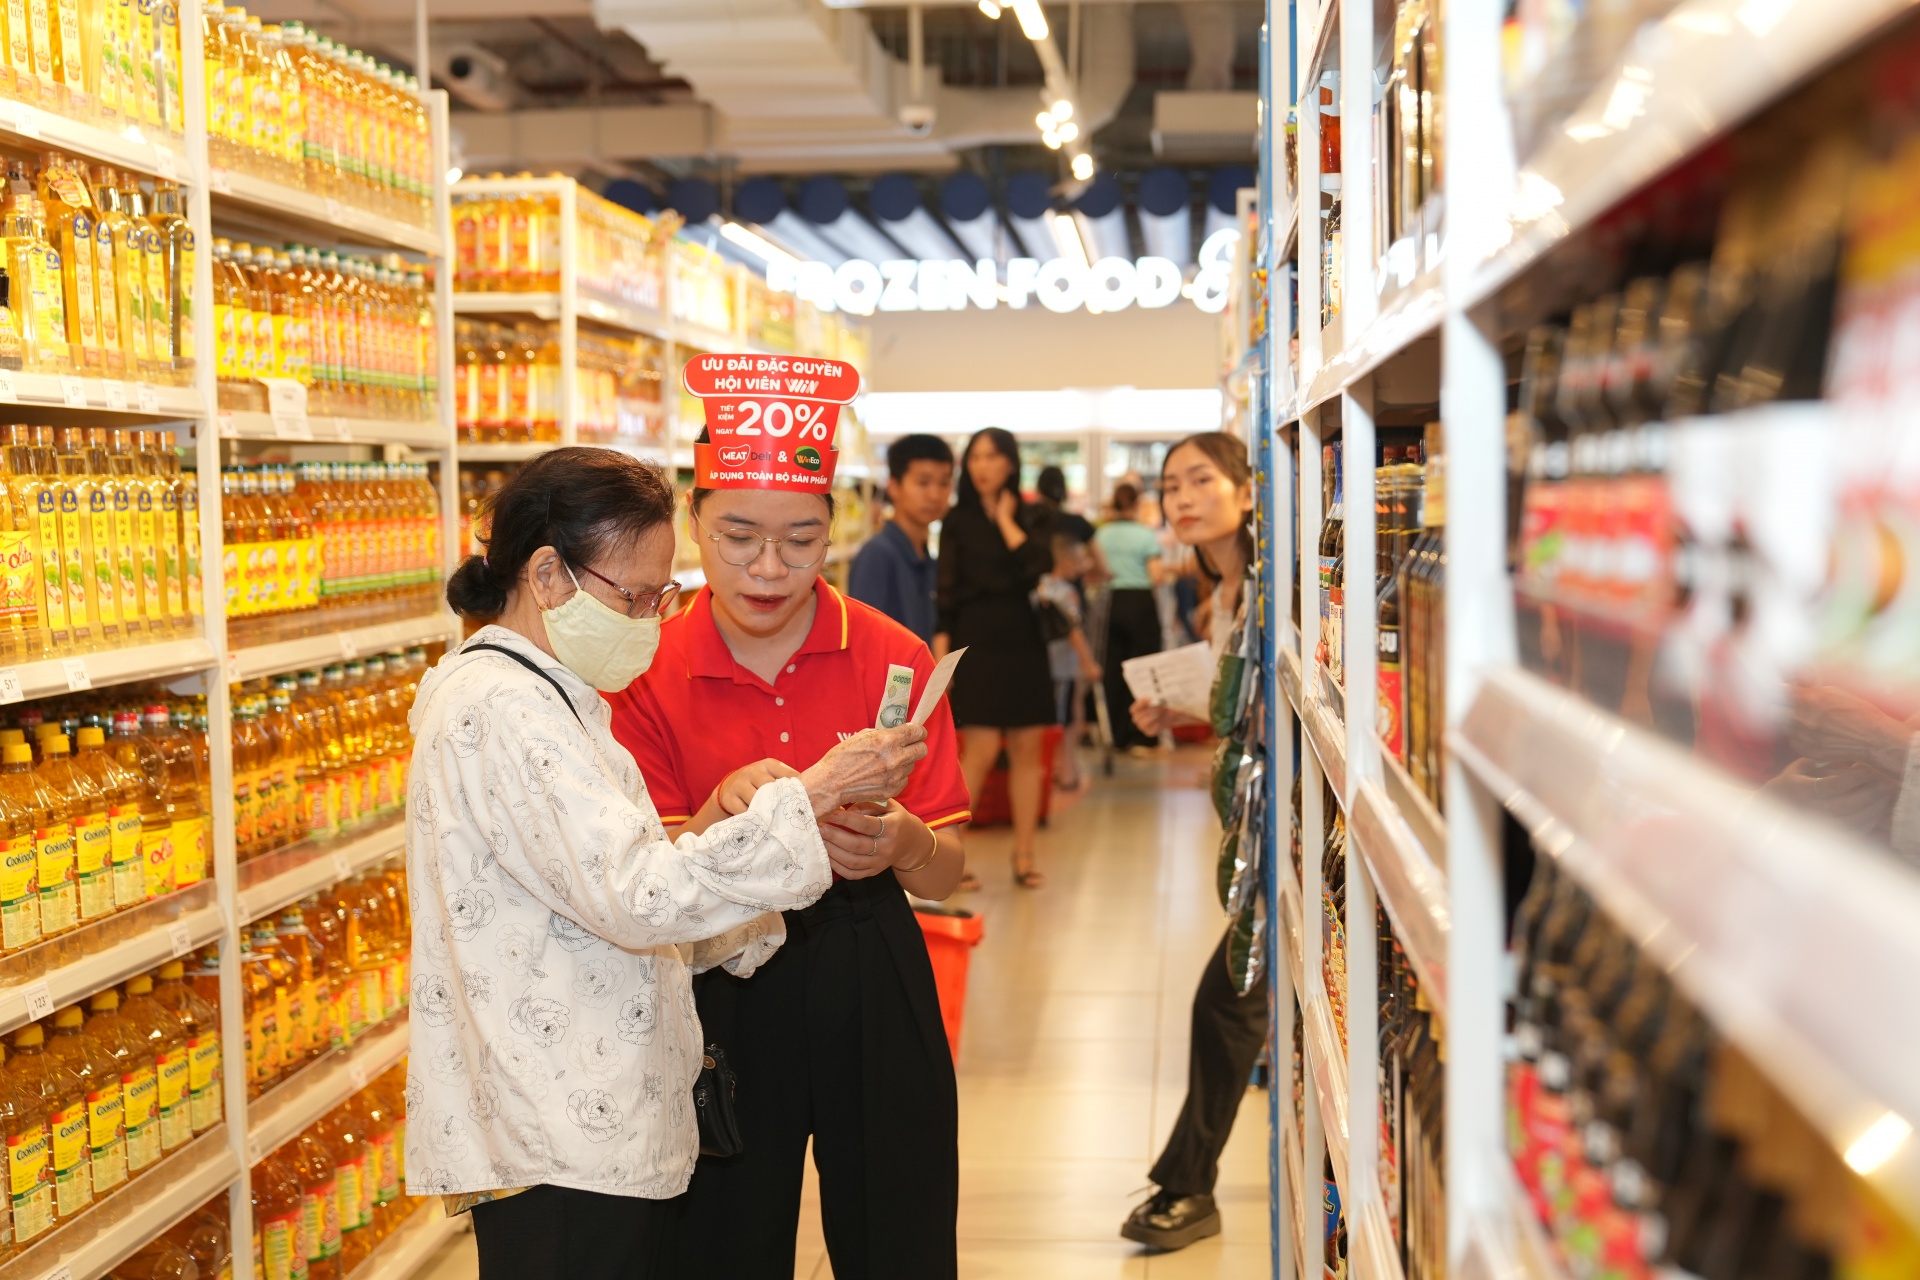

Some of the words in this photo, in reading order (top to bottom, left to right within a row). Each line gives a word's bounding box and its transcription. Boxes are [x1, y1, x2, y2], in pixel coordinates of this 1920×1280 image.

[1008, 256, 1182, 313] FOOD
[702, 357, 723, 370] ƯU
[727, 356, 752, 370] ĐÃI
[756, 358, 789, 375] ĐẶC
[792, 361, 843, 377] QUYỀN
[715, 375, 741, 392] HỘI
[745, 376, 781, 391] VIÊN
[736, 400, 827, 440] 20%
[777, 451, 788, 463] &
[720, 472, 744, 481] DỤNG
[746, 470, 773, 480] TOÀN
[776, 472, 790, 483] BỘ
[34, 996, 46, 1009] 123
